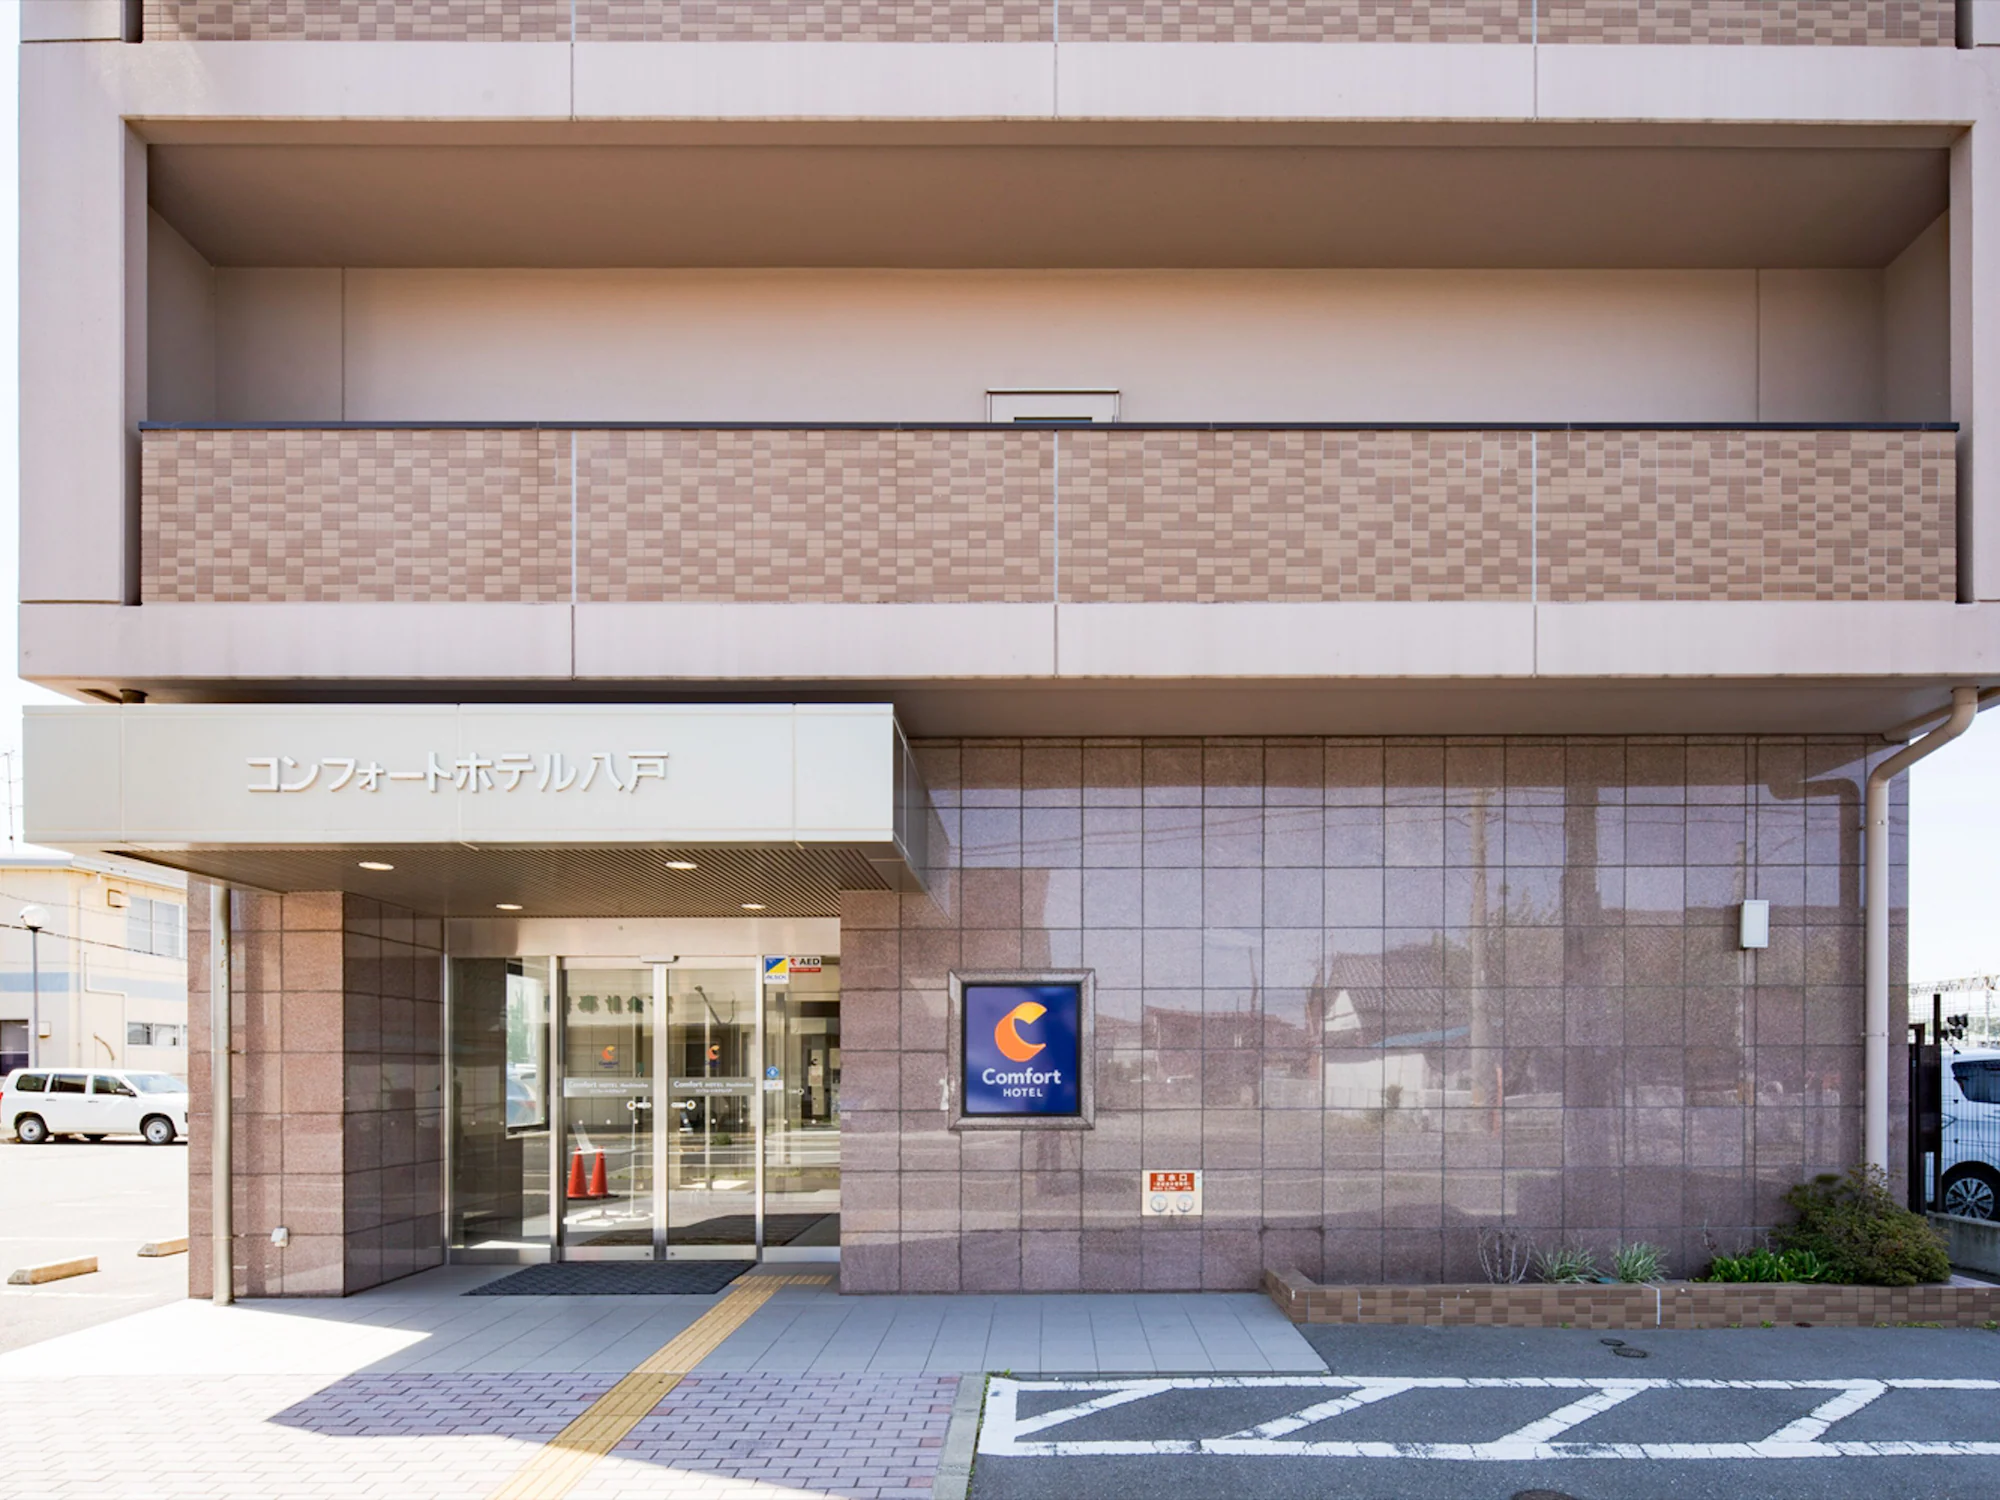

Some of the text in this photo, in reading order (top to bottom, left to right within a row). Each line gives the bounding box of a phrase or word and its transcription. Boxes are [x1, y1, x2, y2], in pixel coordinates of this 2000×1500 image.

[246, 750, 669, 793] コンフォートホテル八戸
[799, 958, 820, 966] AED
[982, 1067, 1062, 1085] Comfort
[673, 1080, 703, 1089] Comfort
[1003, 1088, 1043, 1098] HOTEL
